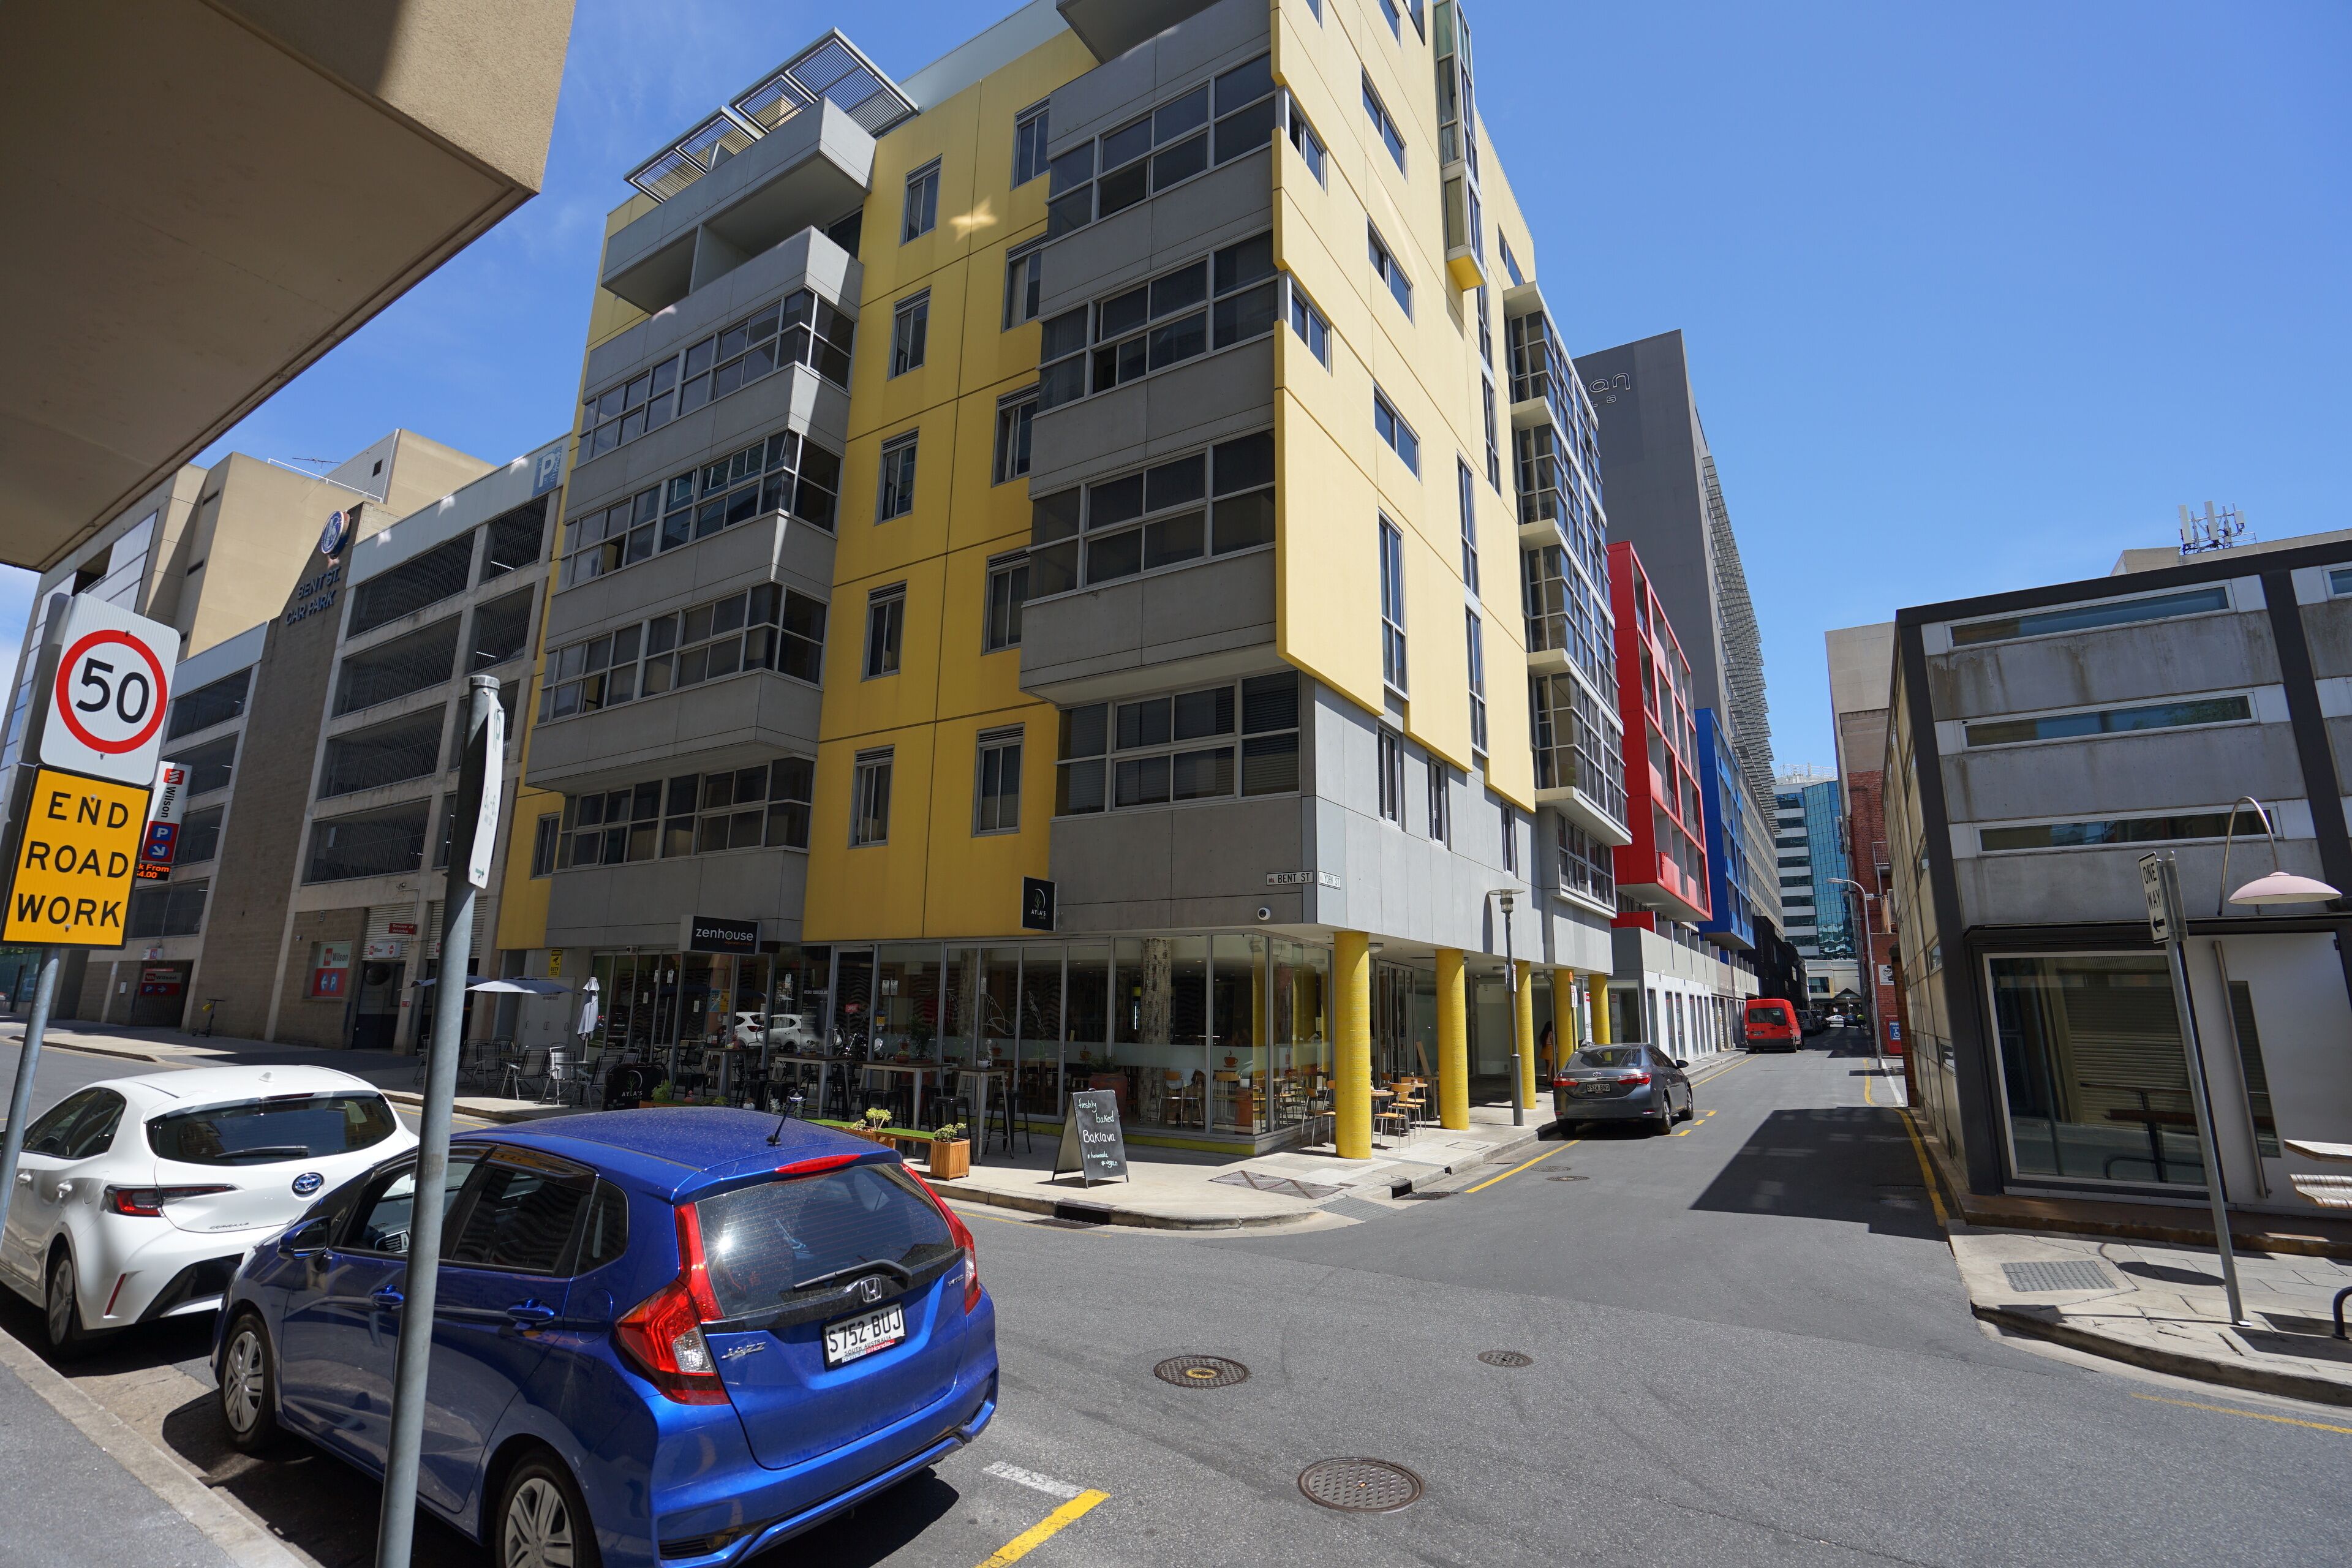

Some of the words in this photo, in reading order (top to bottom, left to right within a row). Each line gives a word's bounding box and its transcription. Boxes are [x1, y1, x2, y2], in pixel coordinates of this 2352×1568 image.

[298, 575, 325, 600] BENT
[326, 566, 341, 587] ST.
[287, 604, 306, 625] CAR
[307, 590, 336, 616] PARK
[75, 657, 149, 724] 50
[47, 791, 129, 829] END
[160, 786, 176, 818] Wilson
[25, 840, 129, 879] ROAD
[146, 864, 170, 873] From
[1278, 873, 1297, 883] BENT
[1300, 873, 1310, 882] ST
[1324, 874, 1333, 884] YORK
[1335, 877, 1340, 886] ST
[2143, 862, 2157, 884] ONE
[17, 892, 122, 928] WORK
[2146, 889, 2161, 910] WAY
[696, 928, 754, 941] zenhouse
[333, 953, 349, 962] Wilson
[1078, 1098, 1098, 1113] freshly
[1095, 1110, 1115, 1123] baked
[1083, 1129, 1117, 1144] Baklava
[721, 1341, 766, 1359] JAZZ
[844, 1346, 862, 1356] SOUTH
[864, 1335, 891, 1349] AUSTRALIA
